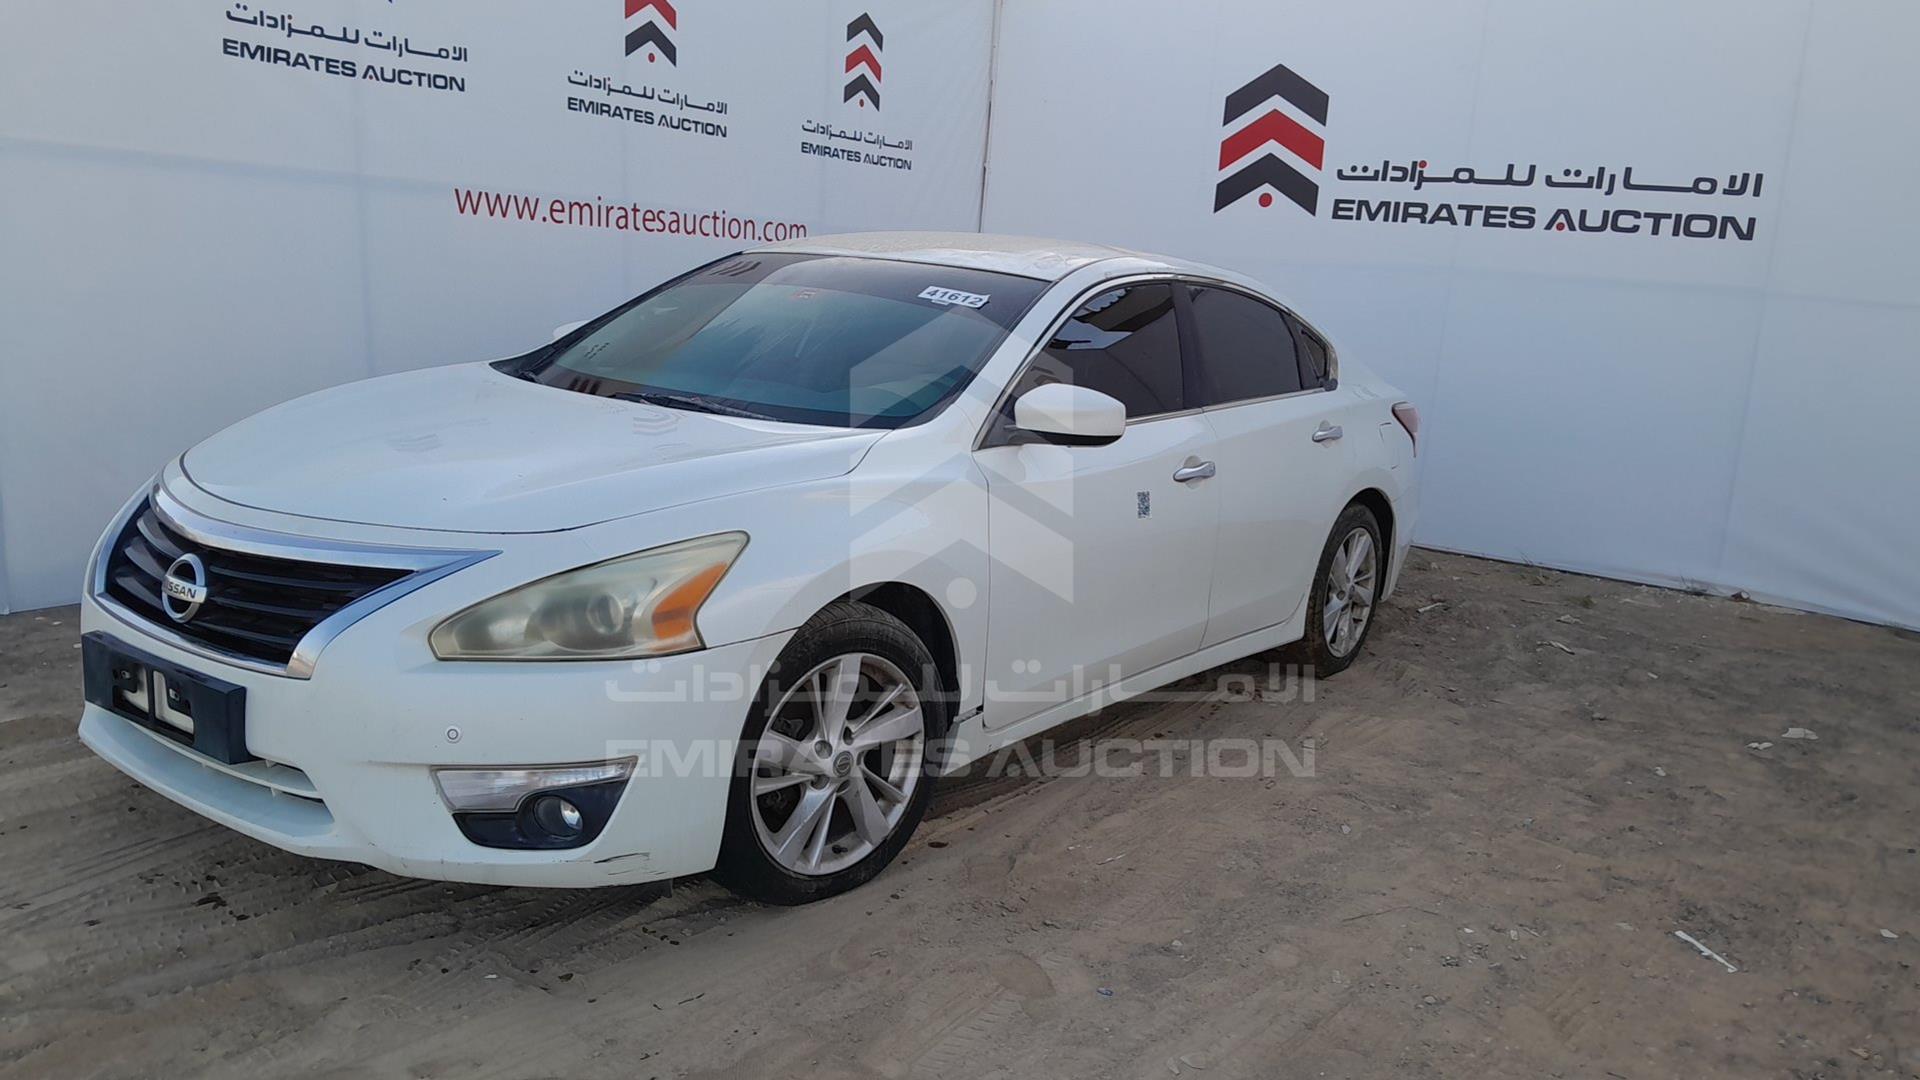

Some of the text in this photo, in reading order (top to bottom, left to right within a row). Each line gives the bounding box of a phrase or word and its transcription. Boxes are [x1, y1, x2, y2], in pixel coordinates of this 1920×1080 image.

[222, 38, 465, 92] EMIRATES AUCTION
[567, 97, 728, 138] EMIRATES AUCTION
[801, 141, 912, 171] EMIRATES AUCTION
[454, 188, 808, 242] www.emiratesauction.com
[1331, 198, 1757, 241] EMIRATES AUCTION
[926, 289, 983, 305] 41612
